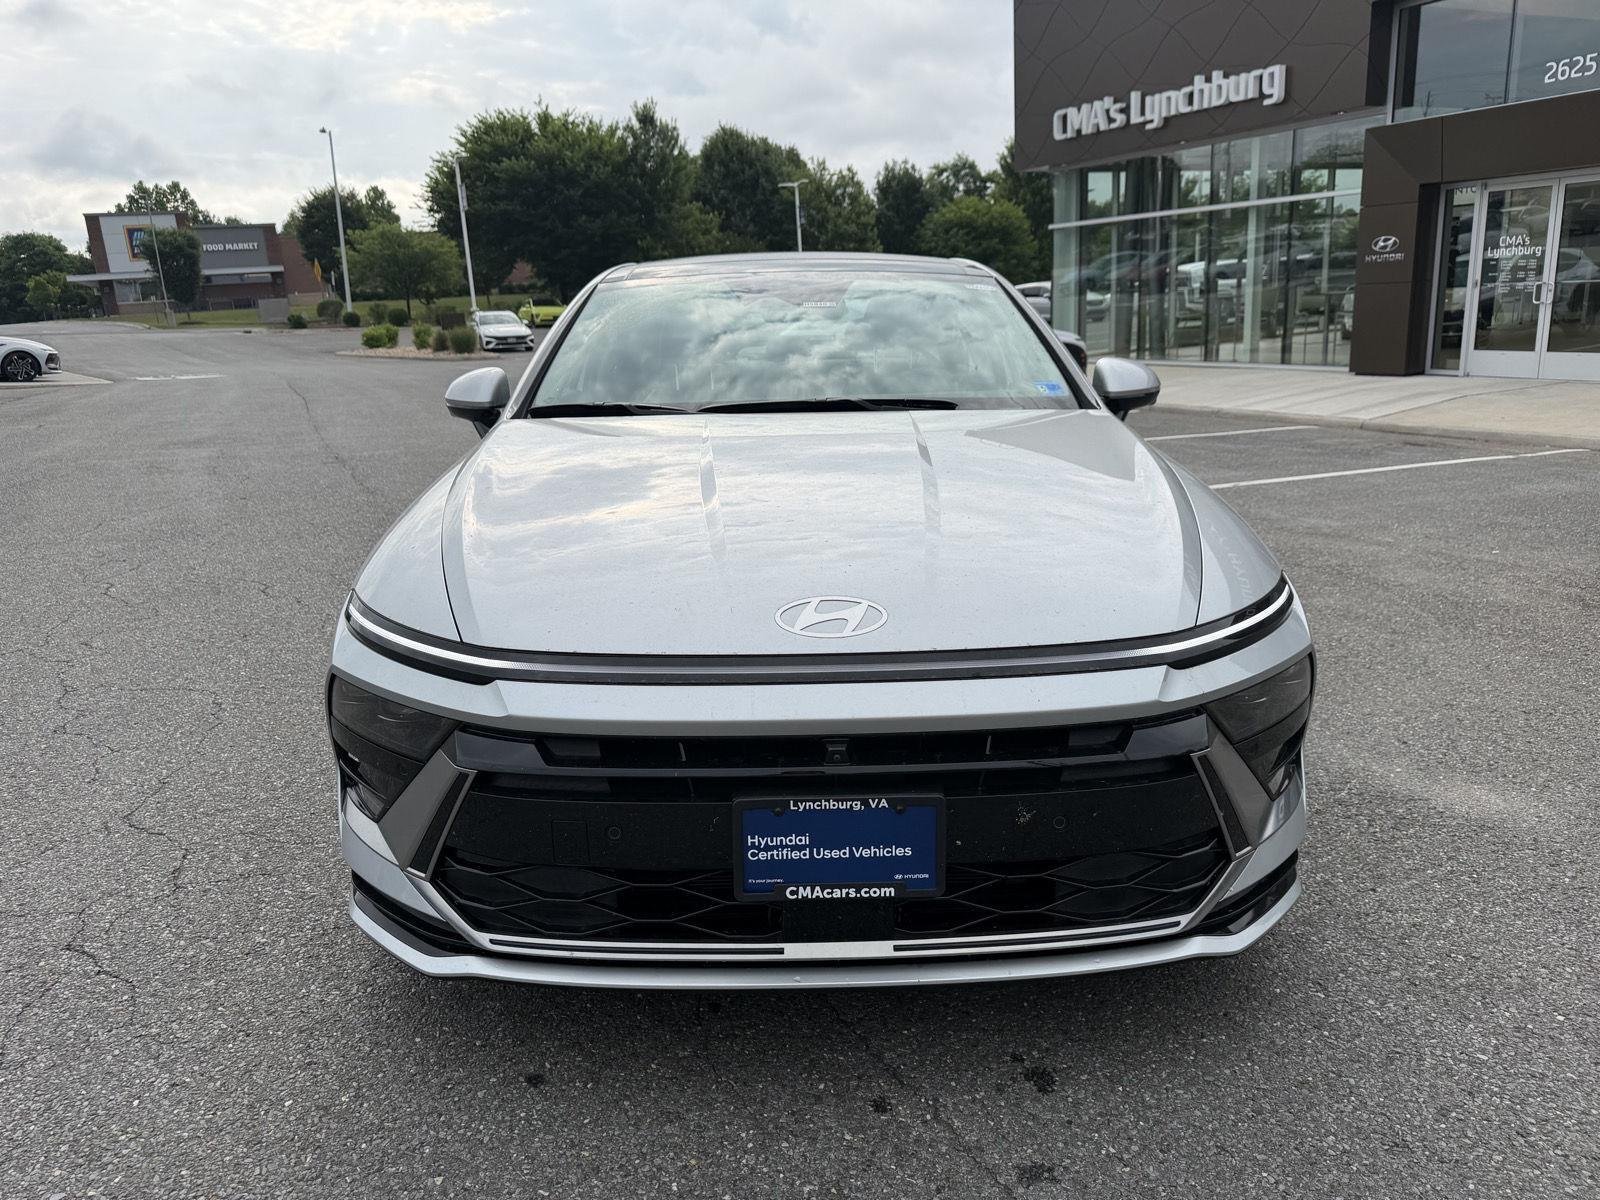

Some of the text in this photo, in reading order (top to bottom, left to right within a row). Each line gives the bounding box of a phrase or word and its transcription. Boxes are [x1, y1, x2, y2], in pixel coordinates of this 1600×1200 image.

[1544, 52, 1598, 83] 2625
[1052, 64, 1287, 141] CMA's Lynchburg
[203, 242, 258, 251] FOOD MARKET
[1499, 234, 1530, 247] CMA's
[1365, 253, 1405, 262] HYUNDAI
[1487, 246, 1542, 259] Lynchburg
[790, 798, 889, 811] Lynchburg, VA
[747, 833, 810, 848] Hyundai
[747, 845, 912, 861] Certified Used Vehicles
[785, 886, 895, 899] CMAcars.com
